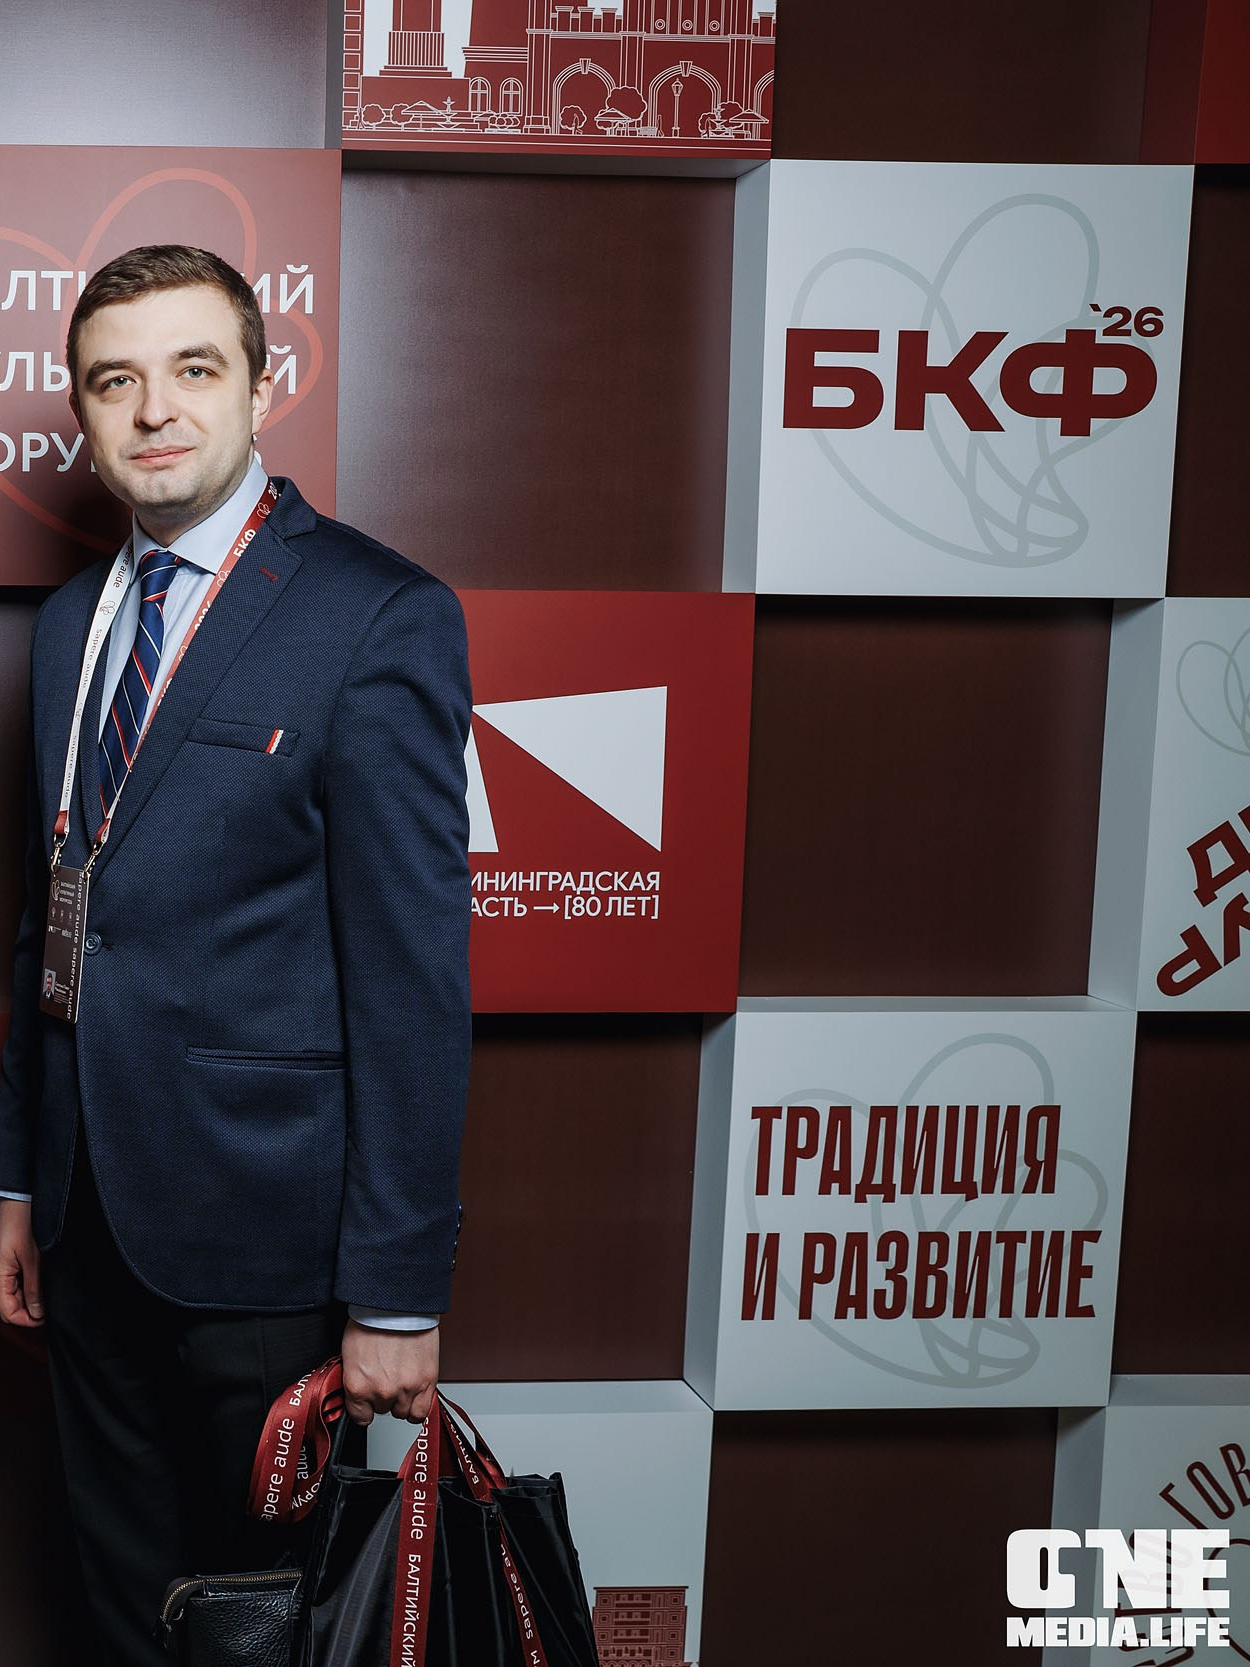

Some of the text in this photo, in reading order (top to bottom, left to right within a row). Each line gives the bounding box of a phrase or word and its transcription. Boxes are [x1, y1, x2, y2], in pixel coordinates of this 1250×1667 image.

[783, 328, 1158, 437] БКФ
[113, 567, 127, 589] aude
[471, 871, 660, 894] ИНИНГРАДСКАЯ
[471, 895, 659, 919] АСТЬ [80 ЛЕТ]
[73, 914, 81, 944] aude
[69, 947, 78, 987] sapere
[66, 990, 74, 1020] aude
[751, 1105, 1062, 1203] ТРАДИЦИЯ
[741, 1230, 1102, 1320] И РАЗВИТИЕ
[260, 1418, 295, 1522] apere aude
[291, 1473, 323, 1510] ОРУМ
[410, 1489, 427, 1540] aude
[510, 1572, 534, 1640] sapere
